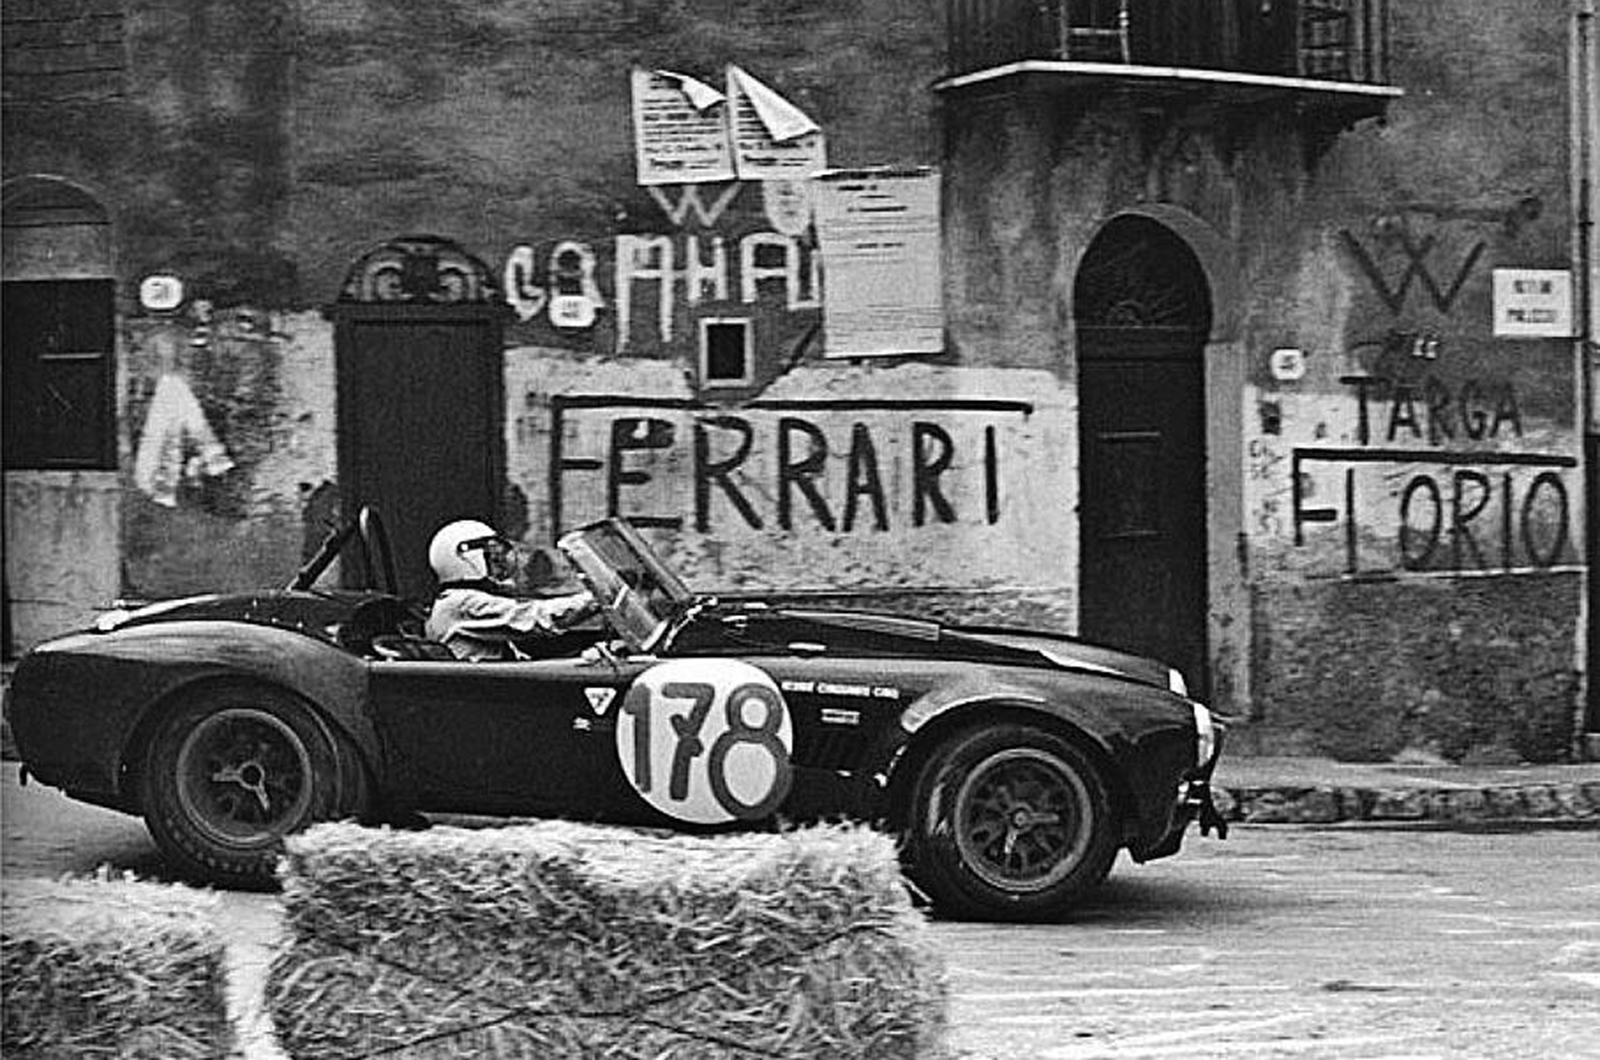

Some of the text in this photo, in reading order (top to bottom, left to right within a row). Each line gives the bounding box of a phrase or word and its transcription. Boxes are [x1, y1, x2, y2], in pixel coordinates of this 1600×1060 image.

[547, 394, 1033, 545] FERRARI
[1339, 374, 1522, 446] TARGA
[624, 682, 793, 820] 178
